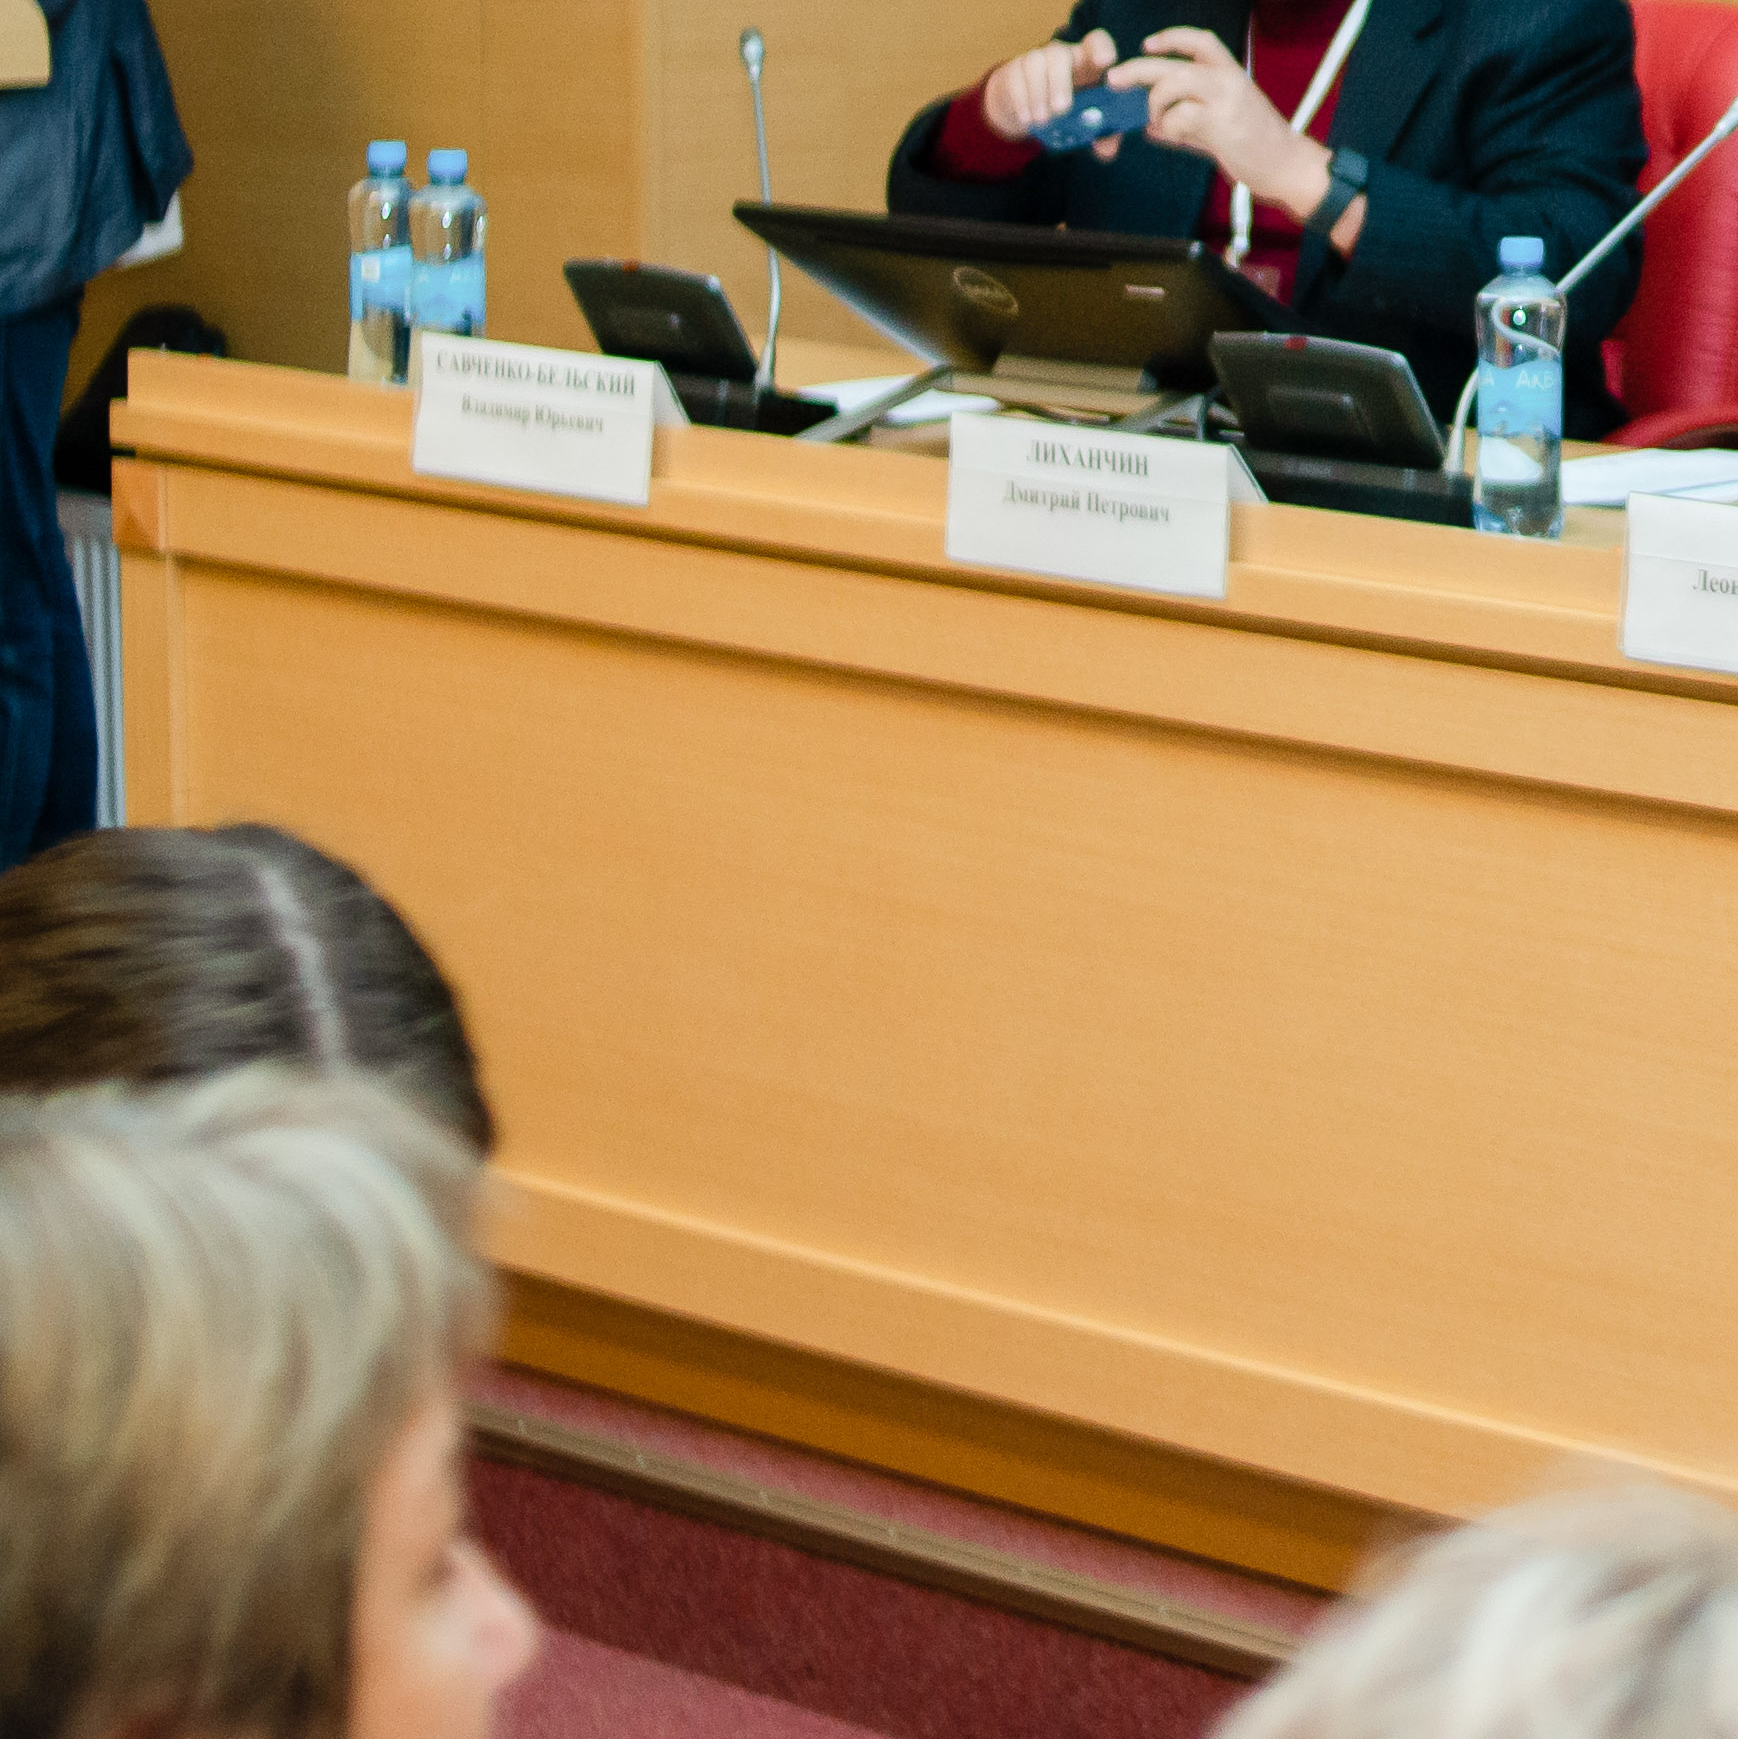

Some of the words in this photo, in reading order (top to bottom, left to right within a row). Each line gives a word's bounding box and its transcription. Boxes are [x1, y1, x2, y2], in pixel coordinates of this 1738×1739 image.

[436, 349, 636, 396] САВЧЕНКО-БЕЛЬСКИЙ
[1026, 439, 1149, 476] ЛИХАНЧИН
[1003, 479, 1080, 512] Дмитрий
[1086, 491, 1170, 523] Петрович
